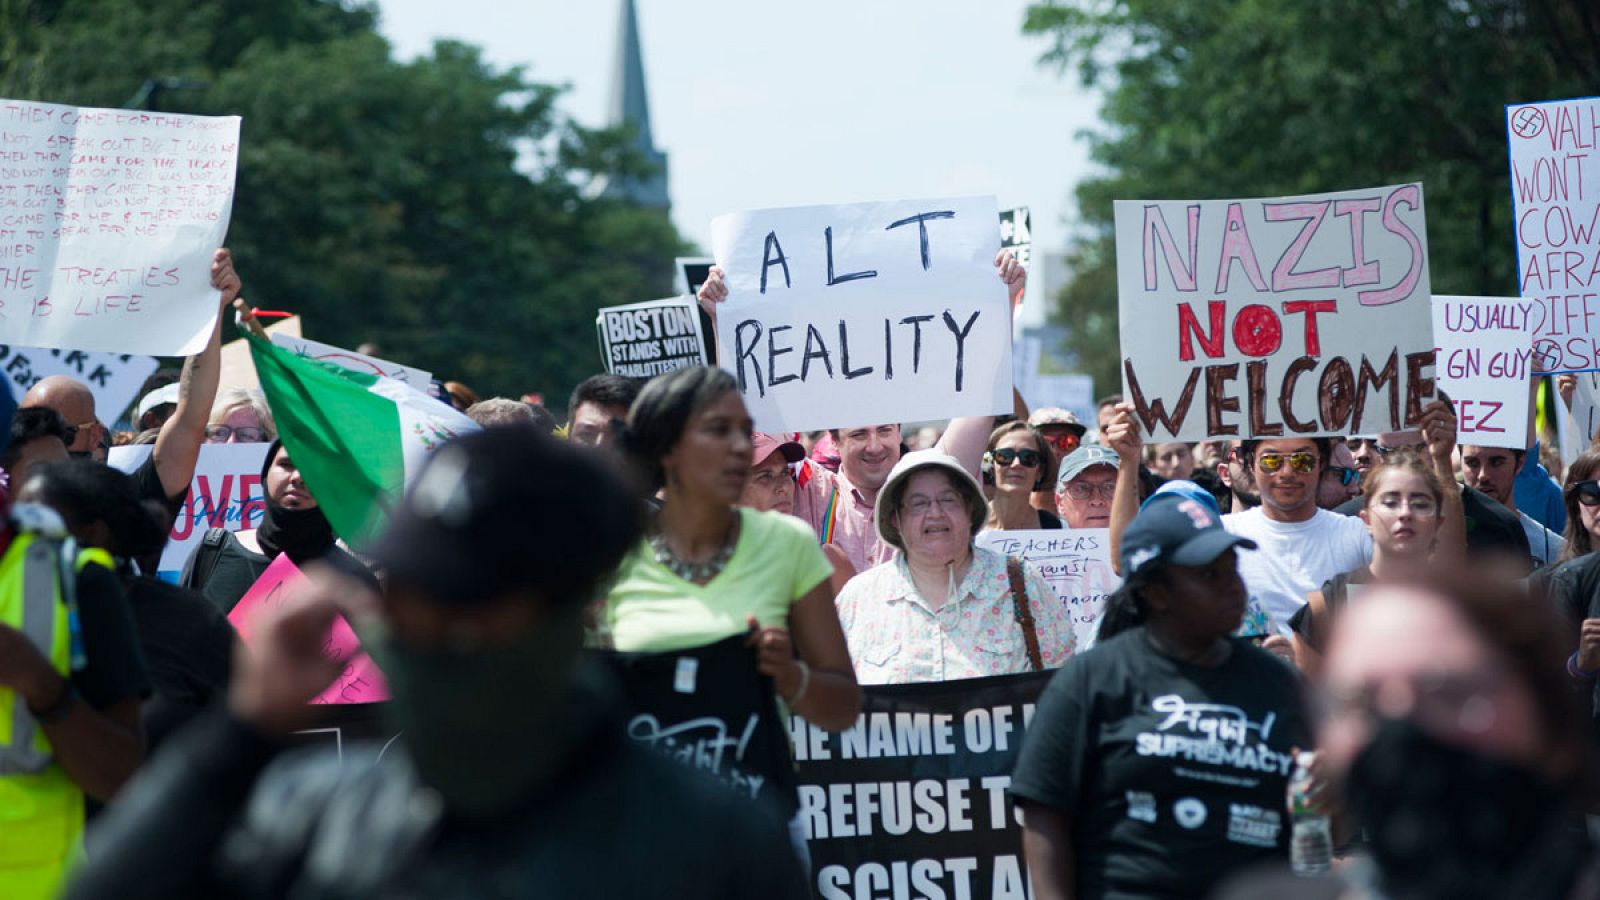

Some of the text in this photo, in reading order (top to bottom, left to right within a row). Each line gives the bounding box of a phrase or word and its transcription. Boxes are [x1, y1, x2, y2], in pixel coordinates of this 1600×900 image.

[5, 105, 55, 122] THEY
[23, 184, 62, 196] THEN
[3, 213, 45, 226] CAME
[25, 230, 45, 240] TO
[759, 210, 957, 294] ALT
[1143, 184, 1424, 306] NAZIS
[59, 266, 180, 289] TREATIES
[32, 296, 52, 317] IS
[75, 294, 143, 317] LIFE
[1444, 303, 1533, 332] USUALLY
[606, 307, 696, 343] BOSTON
[1177, 300, 1338, 362] NOT
[611, 335, 701, 363] STANDS WITH
[735, 309, 981, 398] REALITY
[1487, 347, 1533, 380] GUY
[1122, 346, 1438, 439] WELCOME
[991, 536, 1100, 556] TEACHERS
[840, 711, 956, 760] NAME
[963, 705, 1013, 754] OF
[796, 779, 973, 841] REFUSE
